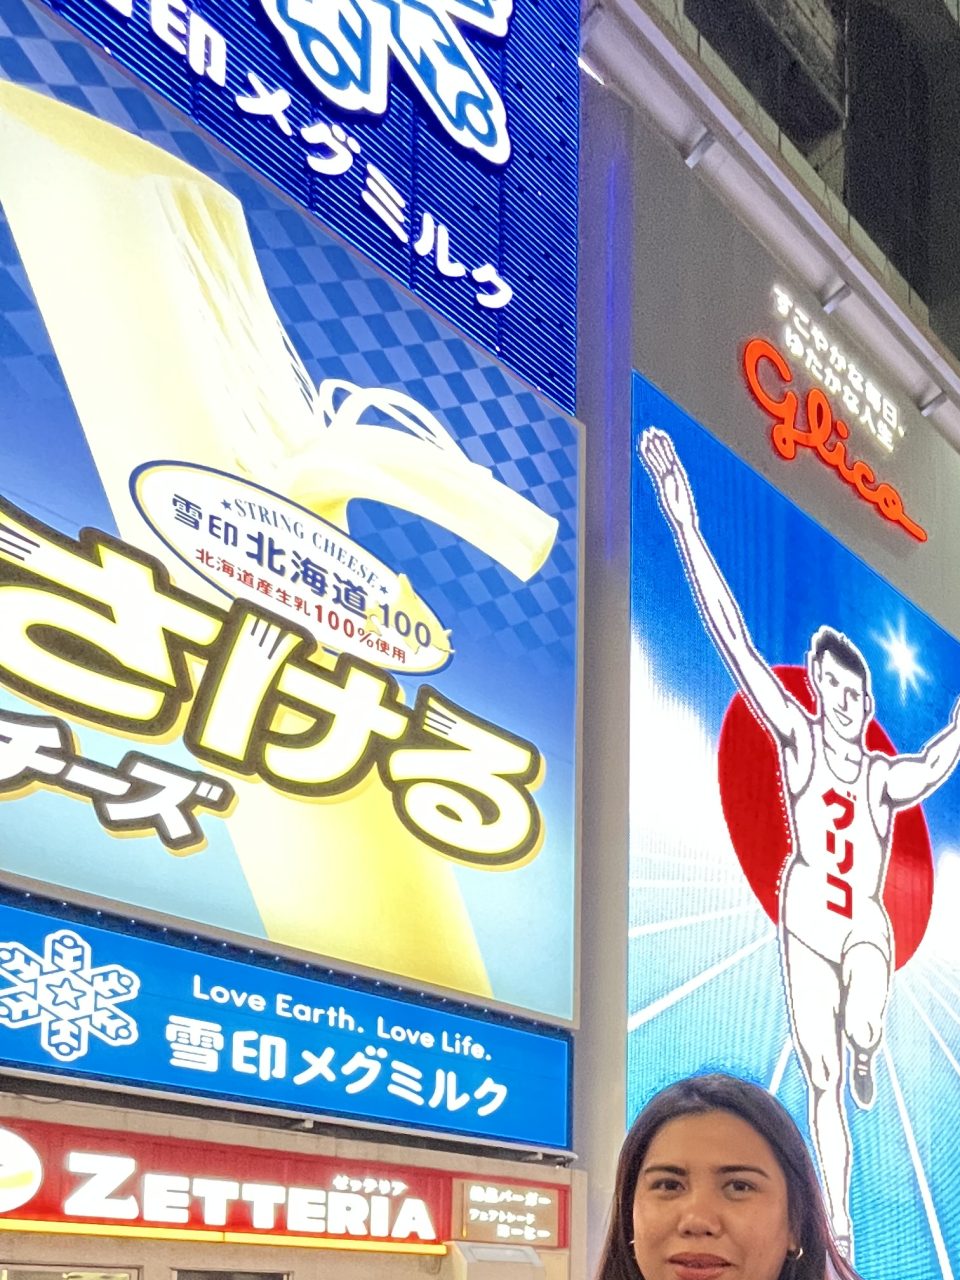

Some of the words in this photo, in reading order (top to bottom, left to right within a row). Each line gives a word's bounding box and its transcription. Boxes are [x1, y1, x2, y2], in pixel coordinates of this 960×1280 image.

[104, 0, 513, 309] 印メグミルク
[743, 338, 928, 543] Glico
[195, 548, 406, 665] 北海道産生乳100%使用
[234, 499, 304, 541] STRING
[312, 531, 379, 589] CHEESE
[0, 499, 541, 866] さける
[821, 787, 857, 920] グリコ
[165, 1014, 508, 1117] 雪印メグミルク
[193, 974, 266, 1012] Love
[276, 993, 365, 1034] Earth.
[377, 1016, 435, 1049] Love
[442, 1030, 492, 1061] Life.
